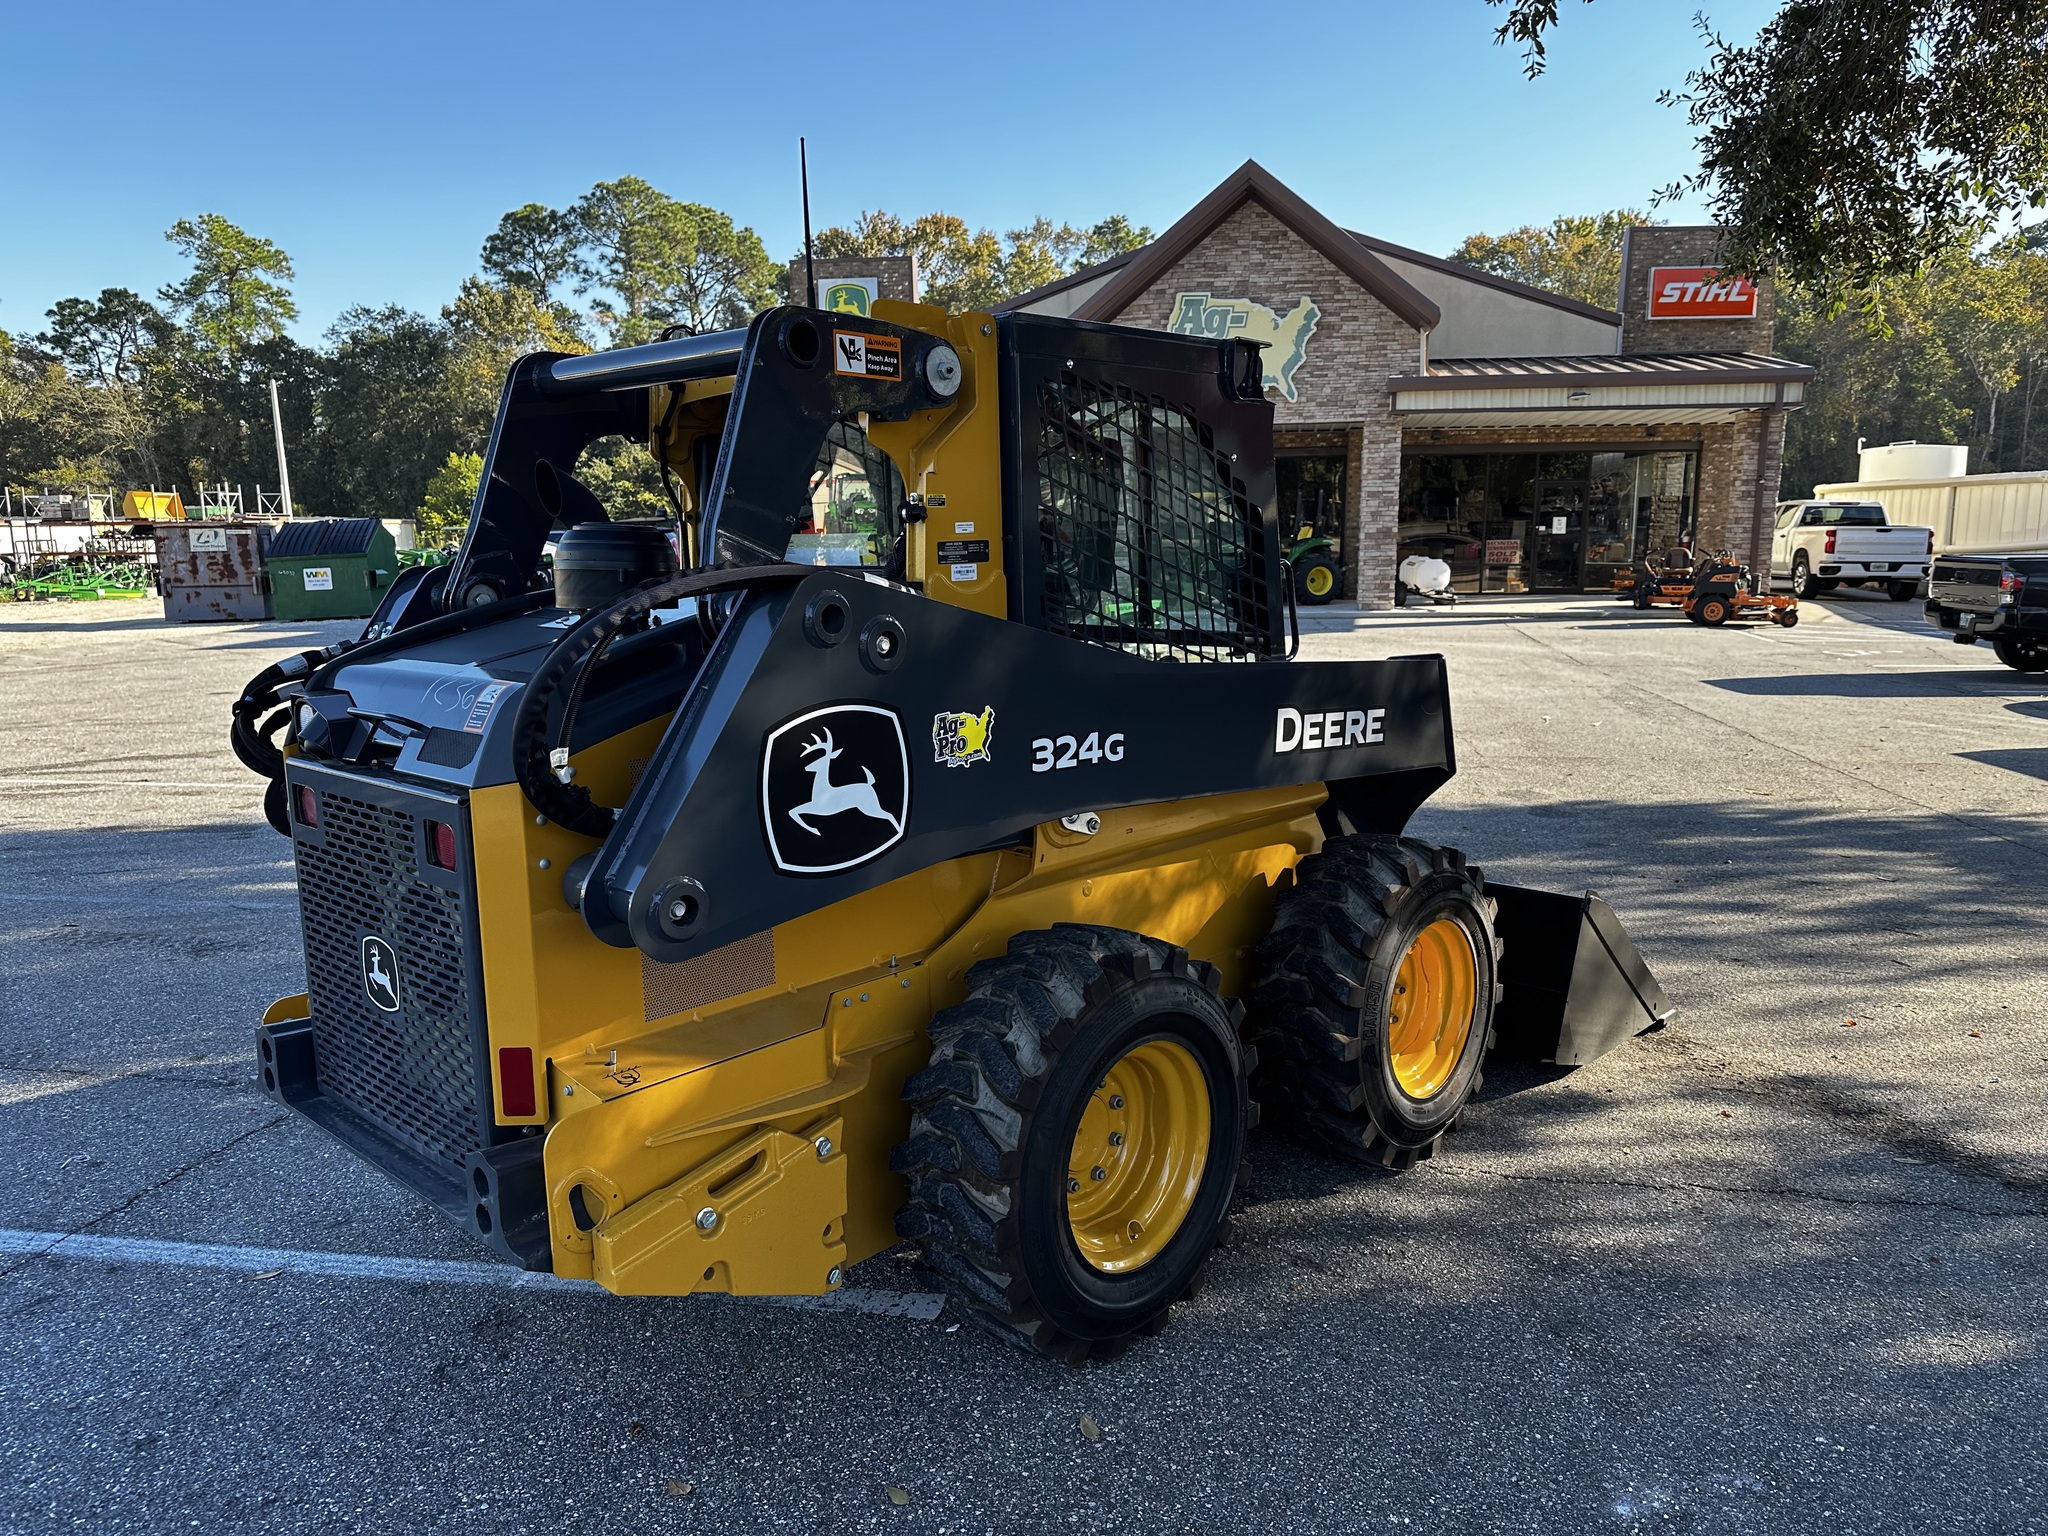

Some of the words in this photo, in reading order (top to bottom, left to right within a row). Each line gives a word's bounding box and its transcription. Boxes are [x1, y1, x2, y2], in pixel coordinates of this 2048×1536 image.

[1658, 280, 1748, 303] STIHL
[1173, 295, 1248, 340] Ag-
[873, 339, 898, 348] WARNING
[867, 354, 884, 362] Pinch
[884, 356, 898, 364] Area
[867, 363, 880, 371] Keep
[880, 365, 894, 373] Away
[935, 714, 967, 740] Ag-
[1275, 707, 1385, 752] DEERE
[936, 736, 969, 759] Pro
[1032, 732, 1124, 773] 324G
